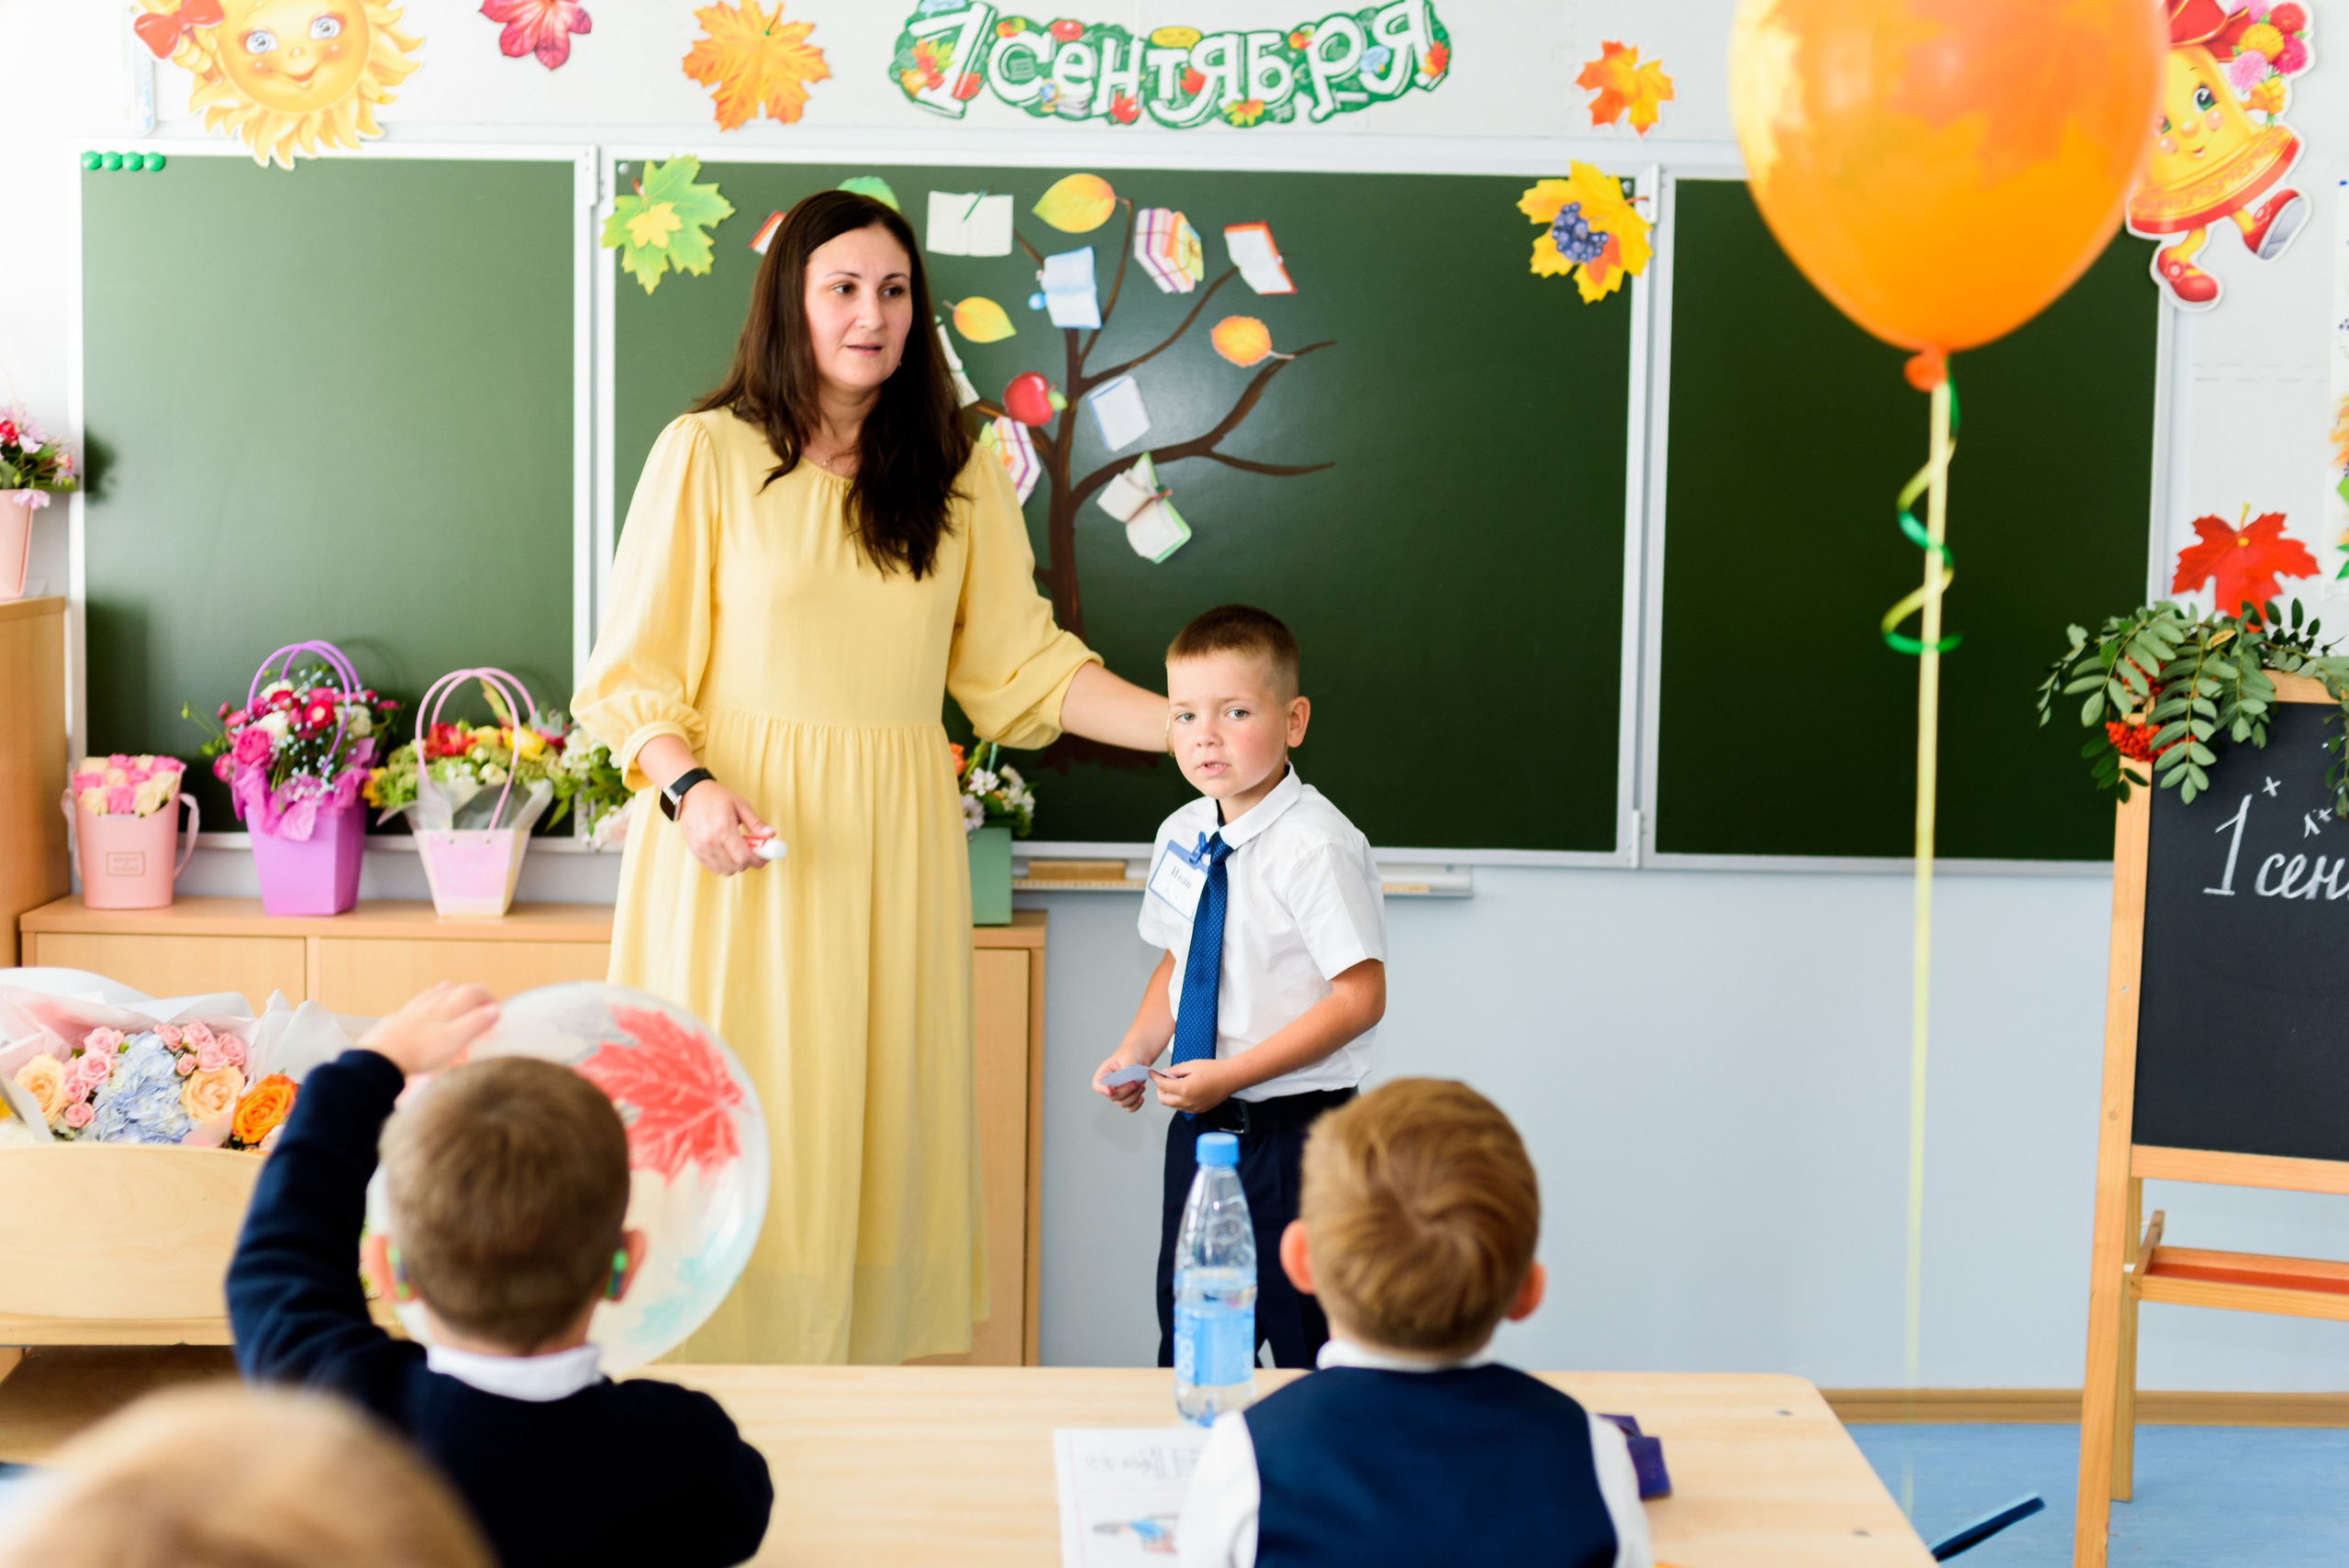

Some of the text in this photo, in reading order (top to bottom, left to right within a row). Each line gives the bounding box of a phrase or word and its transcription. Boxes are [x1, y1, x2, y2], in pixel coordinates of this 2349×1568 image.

[907, 1, 991, 117] 1
[2203, 794, 2349, 900] 1 сен
